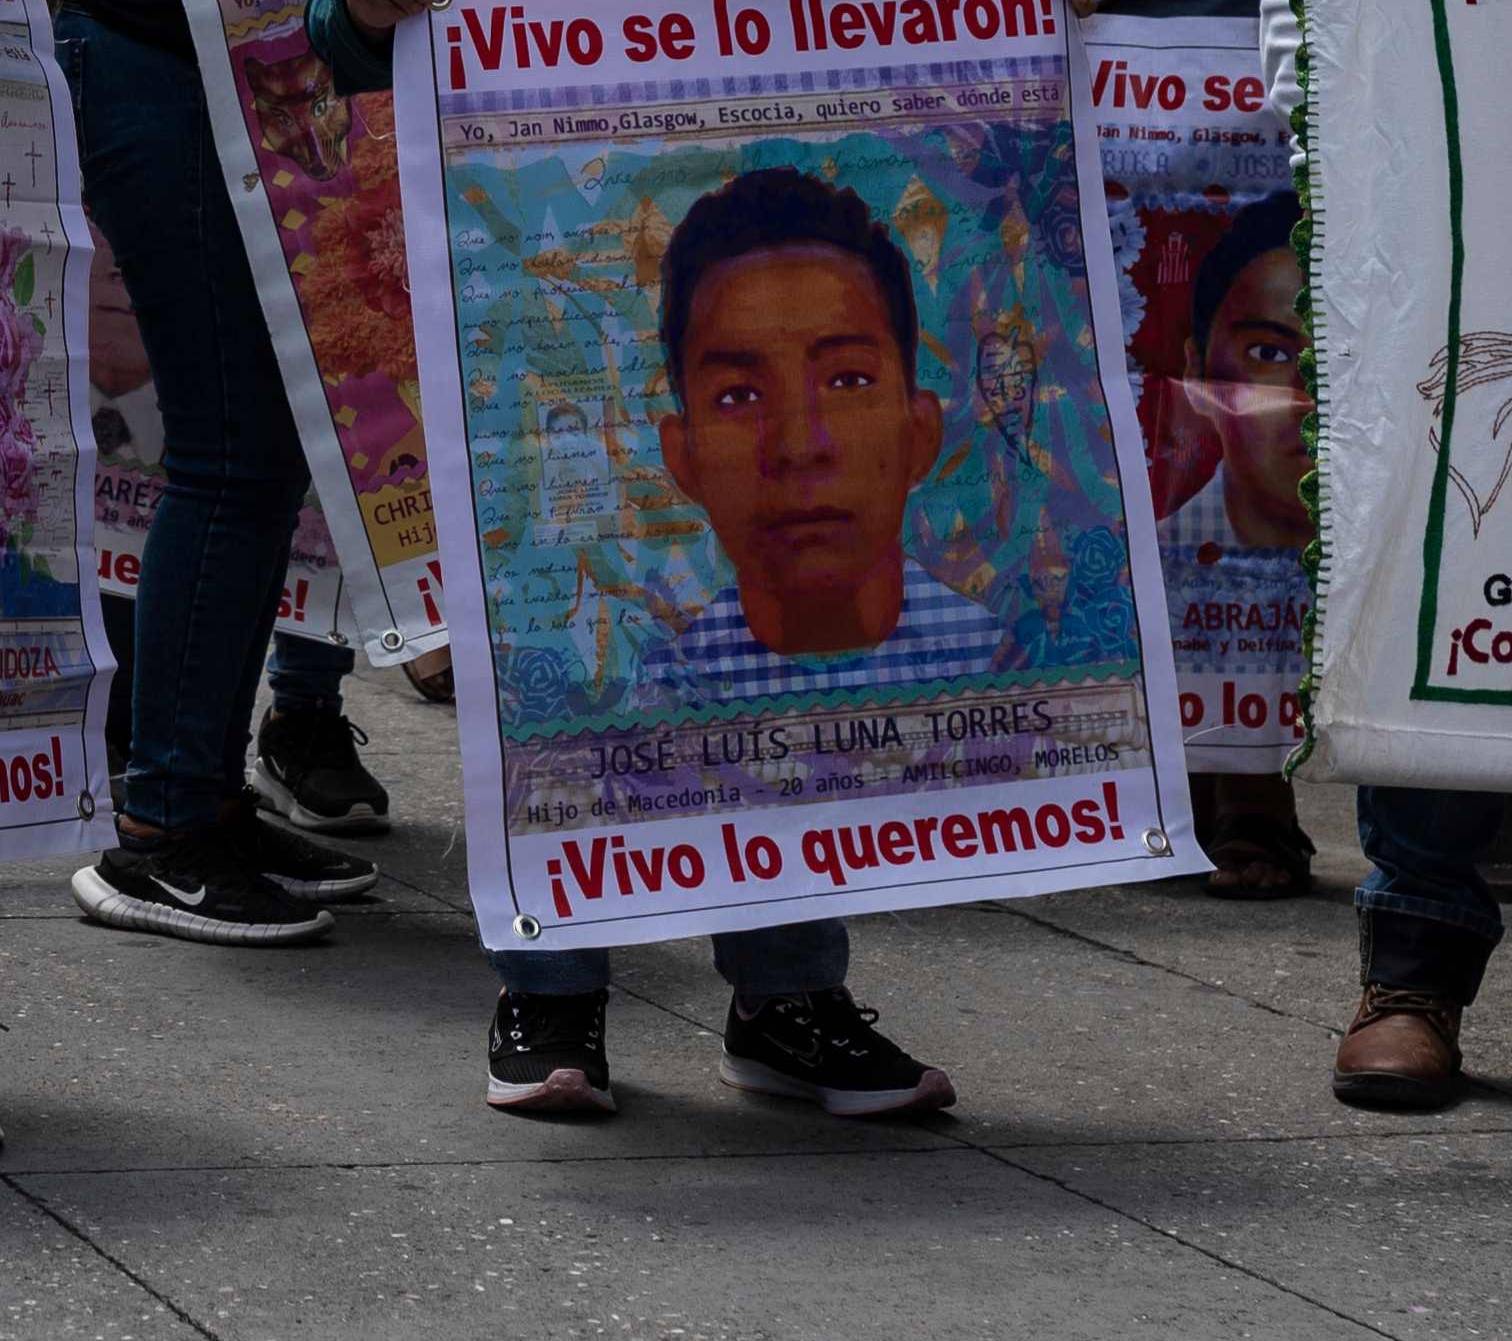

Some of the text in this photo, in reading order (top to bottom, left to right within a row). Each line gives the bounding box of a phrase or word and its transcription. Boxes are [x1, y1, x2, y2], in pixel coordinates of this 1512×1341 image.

[446, 5, 603, 90] ¡Vivo
[622, 12, 695, 62] se
[460, 124, 494, 143] Yo,
[508, 120, 543, 138] Jan
[718, 102, 804, 125] Escocia,
[815, 97, 881, 119] quiero
[891, 92, 946, 111] saber
[956, 87, 1012, 106] dónde
[1021, 84, 1060, 103] está
[1202, 74, 1265, 113] se
[1128, 125, 1182, 144] Nimmo,
[1192, 126, 1266, 146] Glasgow,
[102, 506, 120, 523] 19
[398, 523, 436, 548] Hij
[1219, 640, 1230, 655] y
[1237, 636, 1302, 654] Delfina,
[1222, 680, 1268, 729] lo
[589, 700, 1054, 780] JOSÉ LUÍS LUNA TORRES
[526, 803, 579, 827] Hijo
[590, 797, 617, 817] de
[627, 784, 741, 813] Macedonia
[779, 776, 804, 797] 20
[815, 771, 865, 793] años
[902, 753, 1022, 784] AMILCINGO,
[1034, 741, 1120, 769] MORELOS
[546, 781, 1125, 918] ¡Vivo lo queremos!
